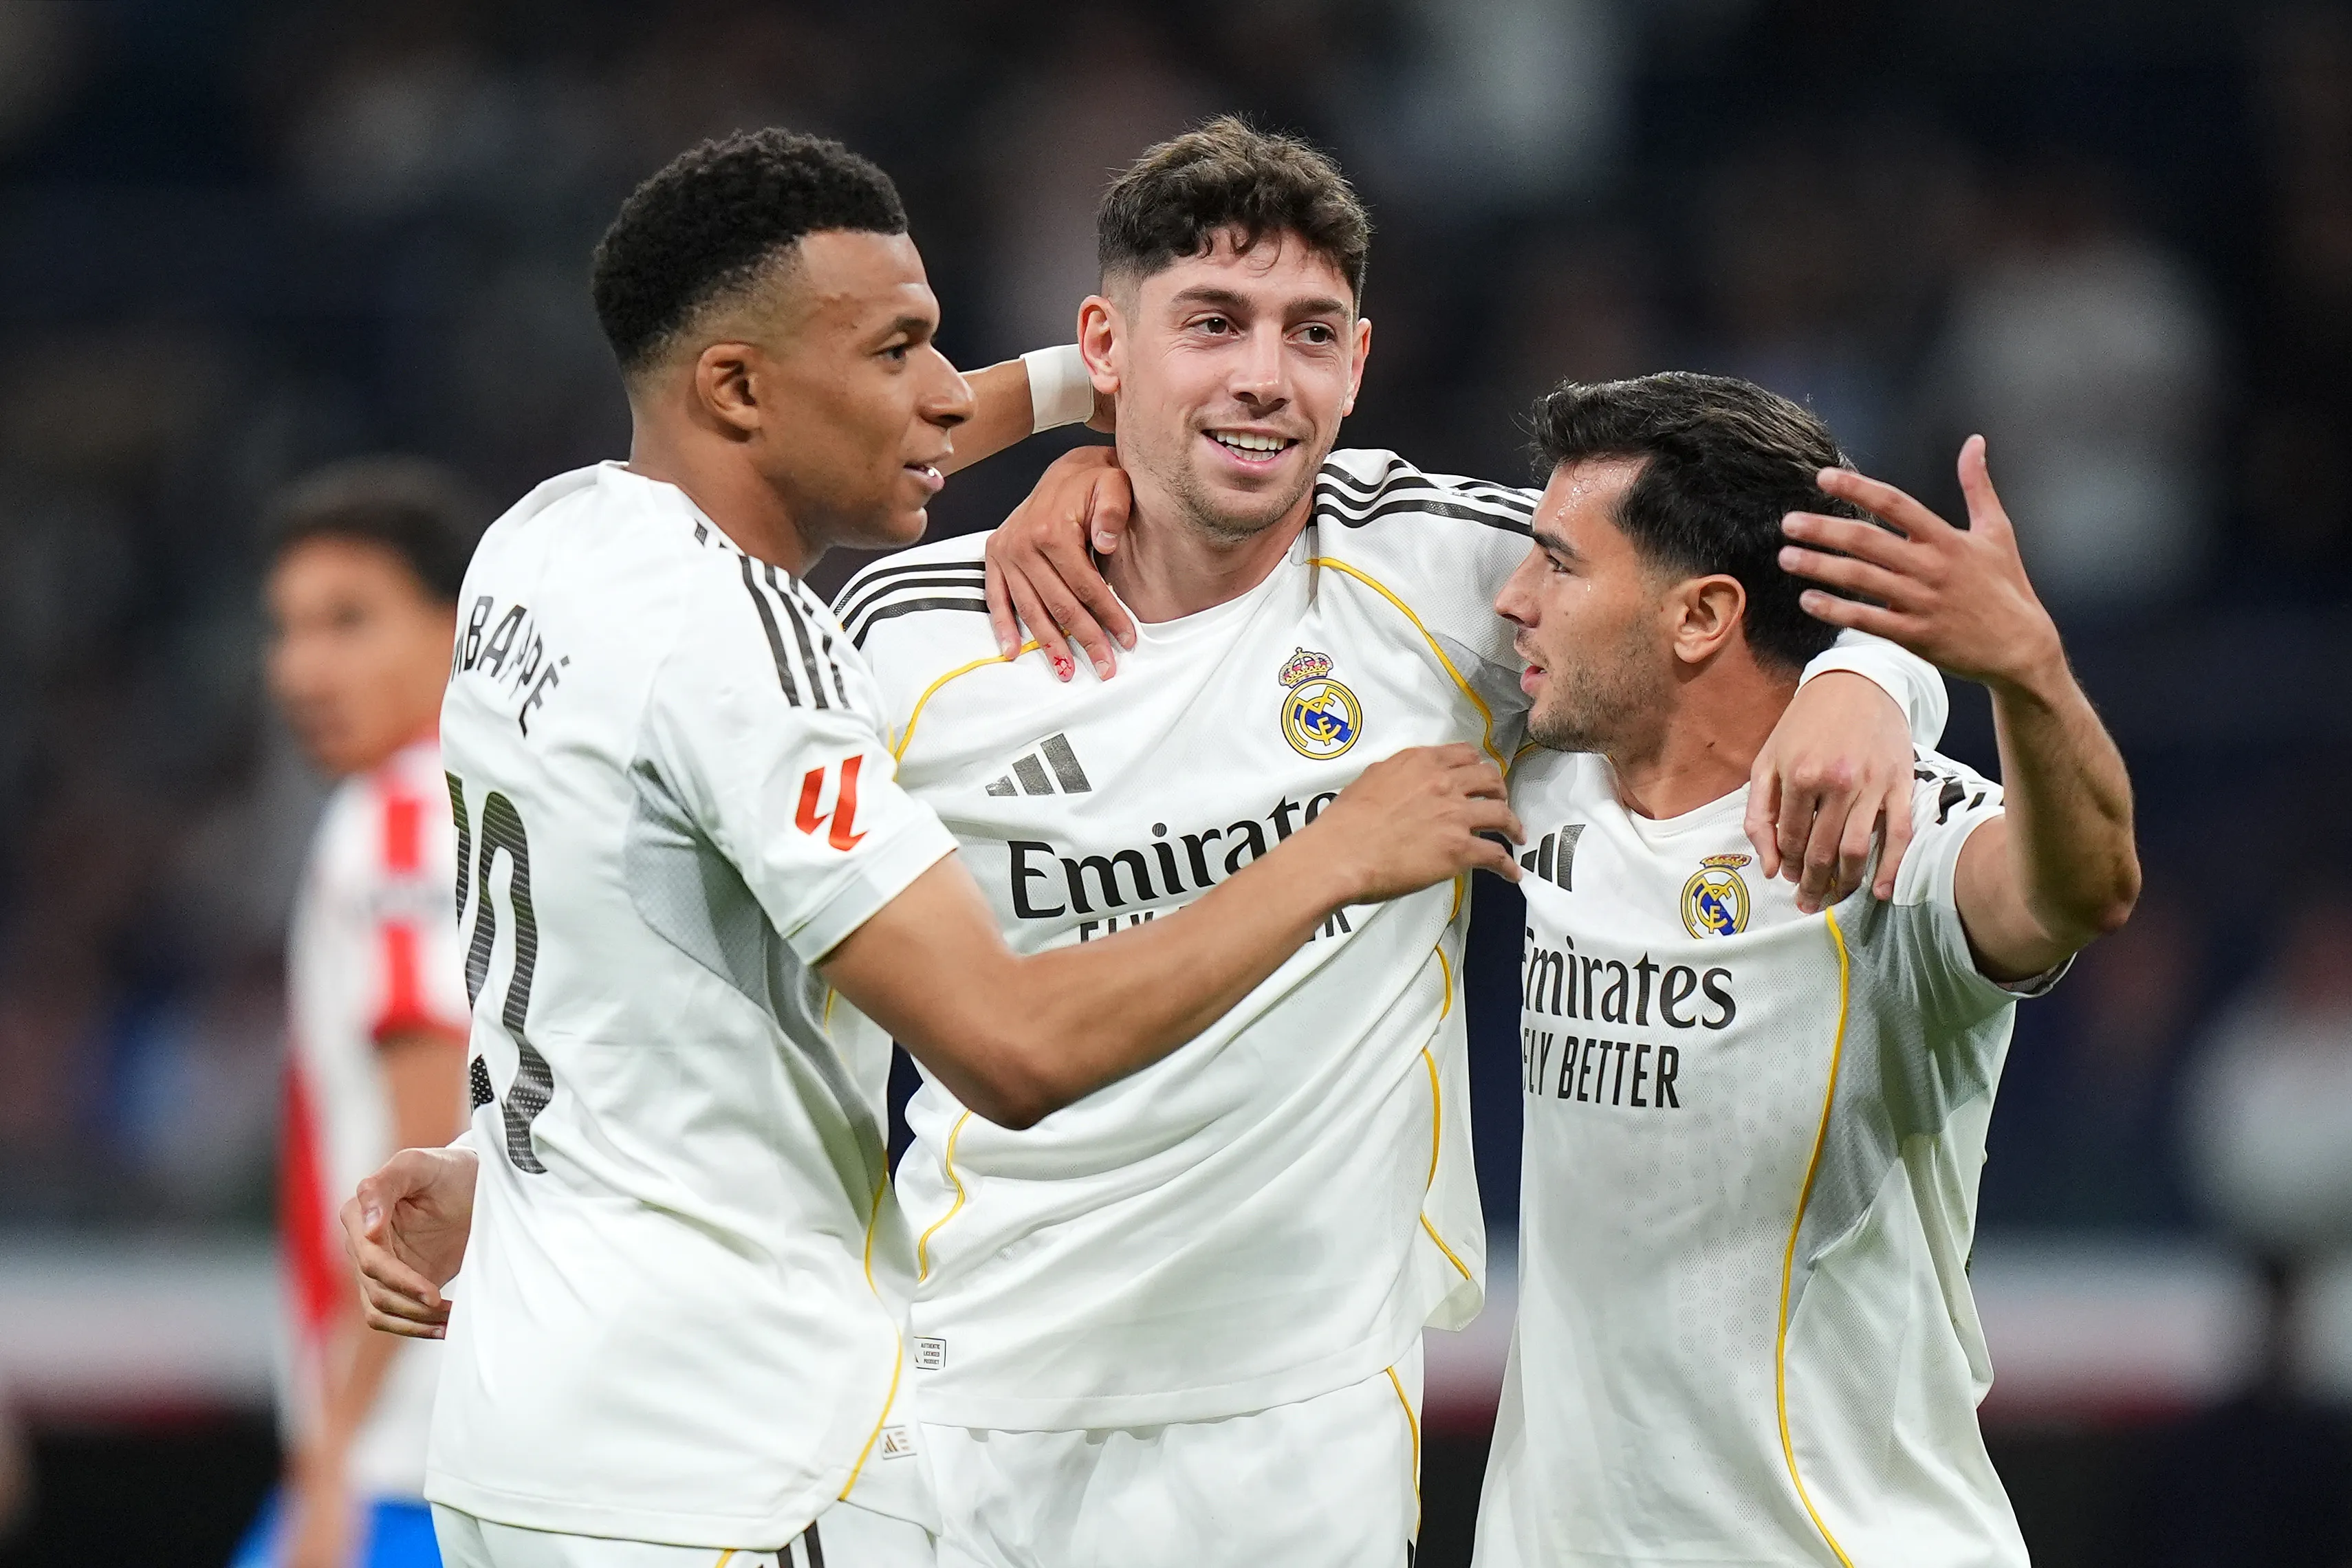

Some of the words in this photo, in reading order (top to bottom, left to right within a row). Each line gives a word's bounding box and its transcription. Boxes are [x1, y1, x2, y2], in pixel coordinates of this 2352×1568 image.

[1008, 792, 1340, 919] Emirat
[1521, 926, 1736, 1030] mirates
[1557, 1036, 1680, 1109] BETTER
